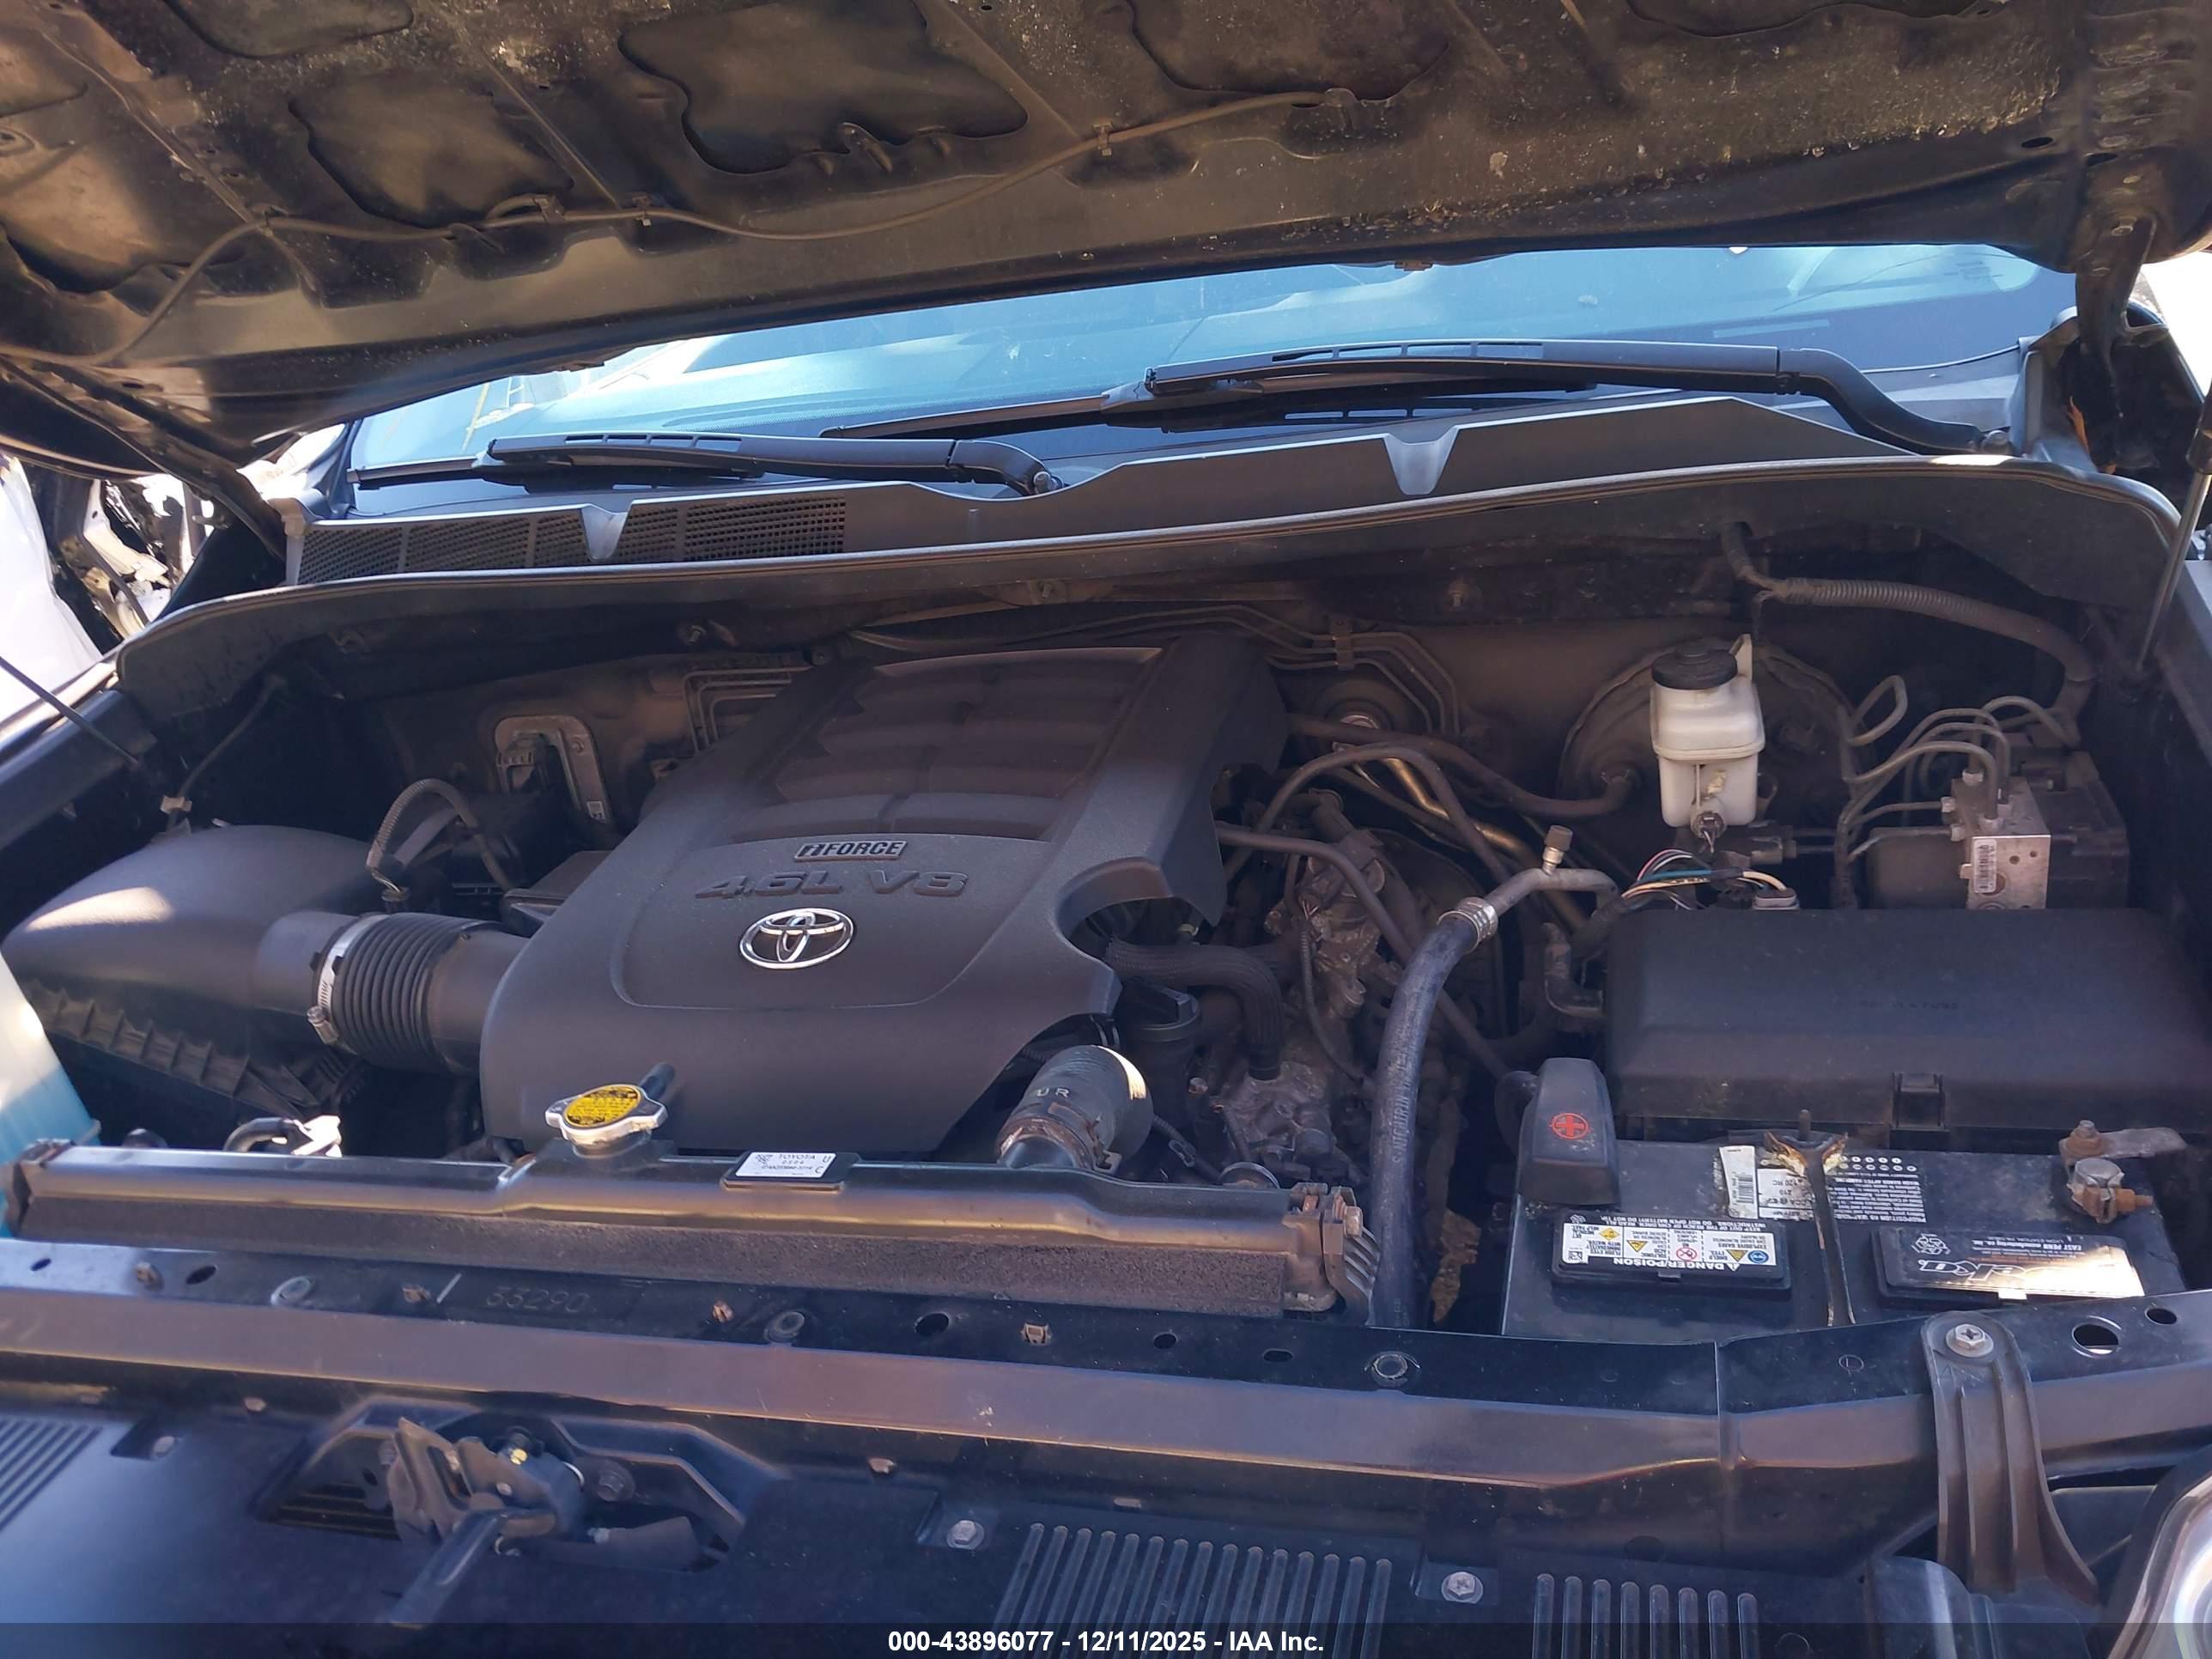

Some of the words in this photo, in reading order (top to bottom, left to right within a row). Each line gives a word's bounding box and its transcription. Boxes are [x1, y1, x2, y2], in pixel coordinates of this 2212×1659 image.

[696, 871, 844, 899] 4.6L
[867, 870, 969, 897] V8
[1613, 1258, 1725, 1271] DANGER/POISON
